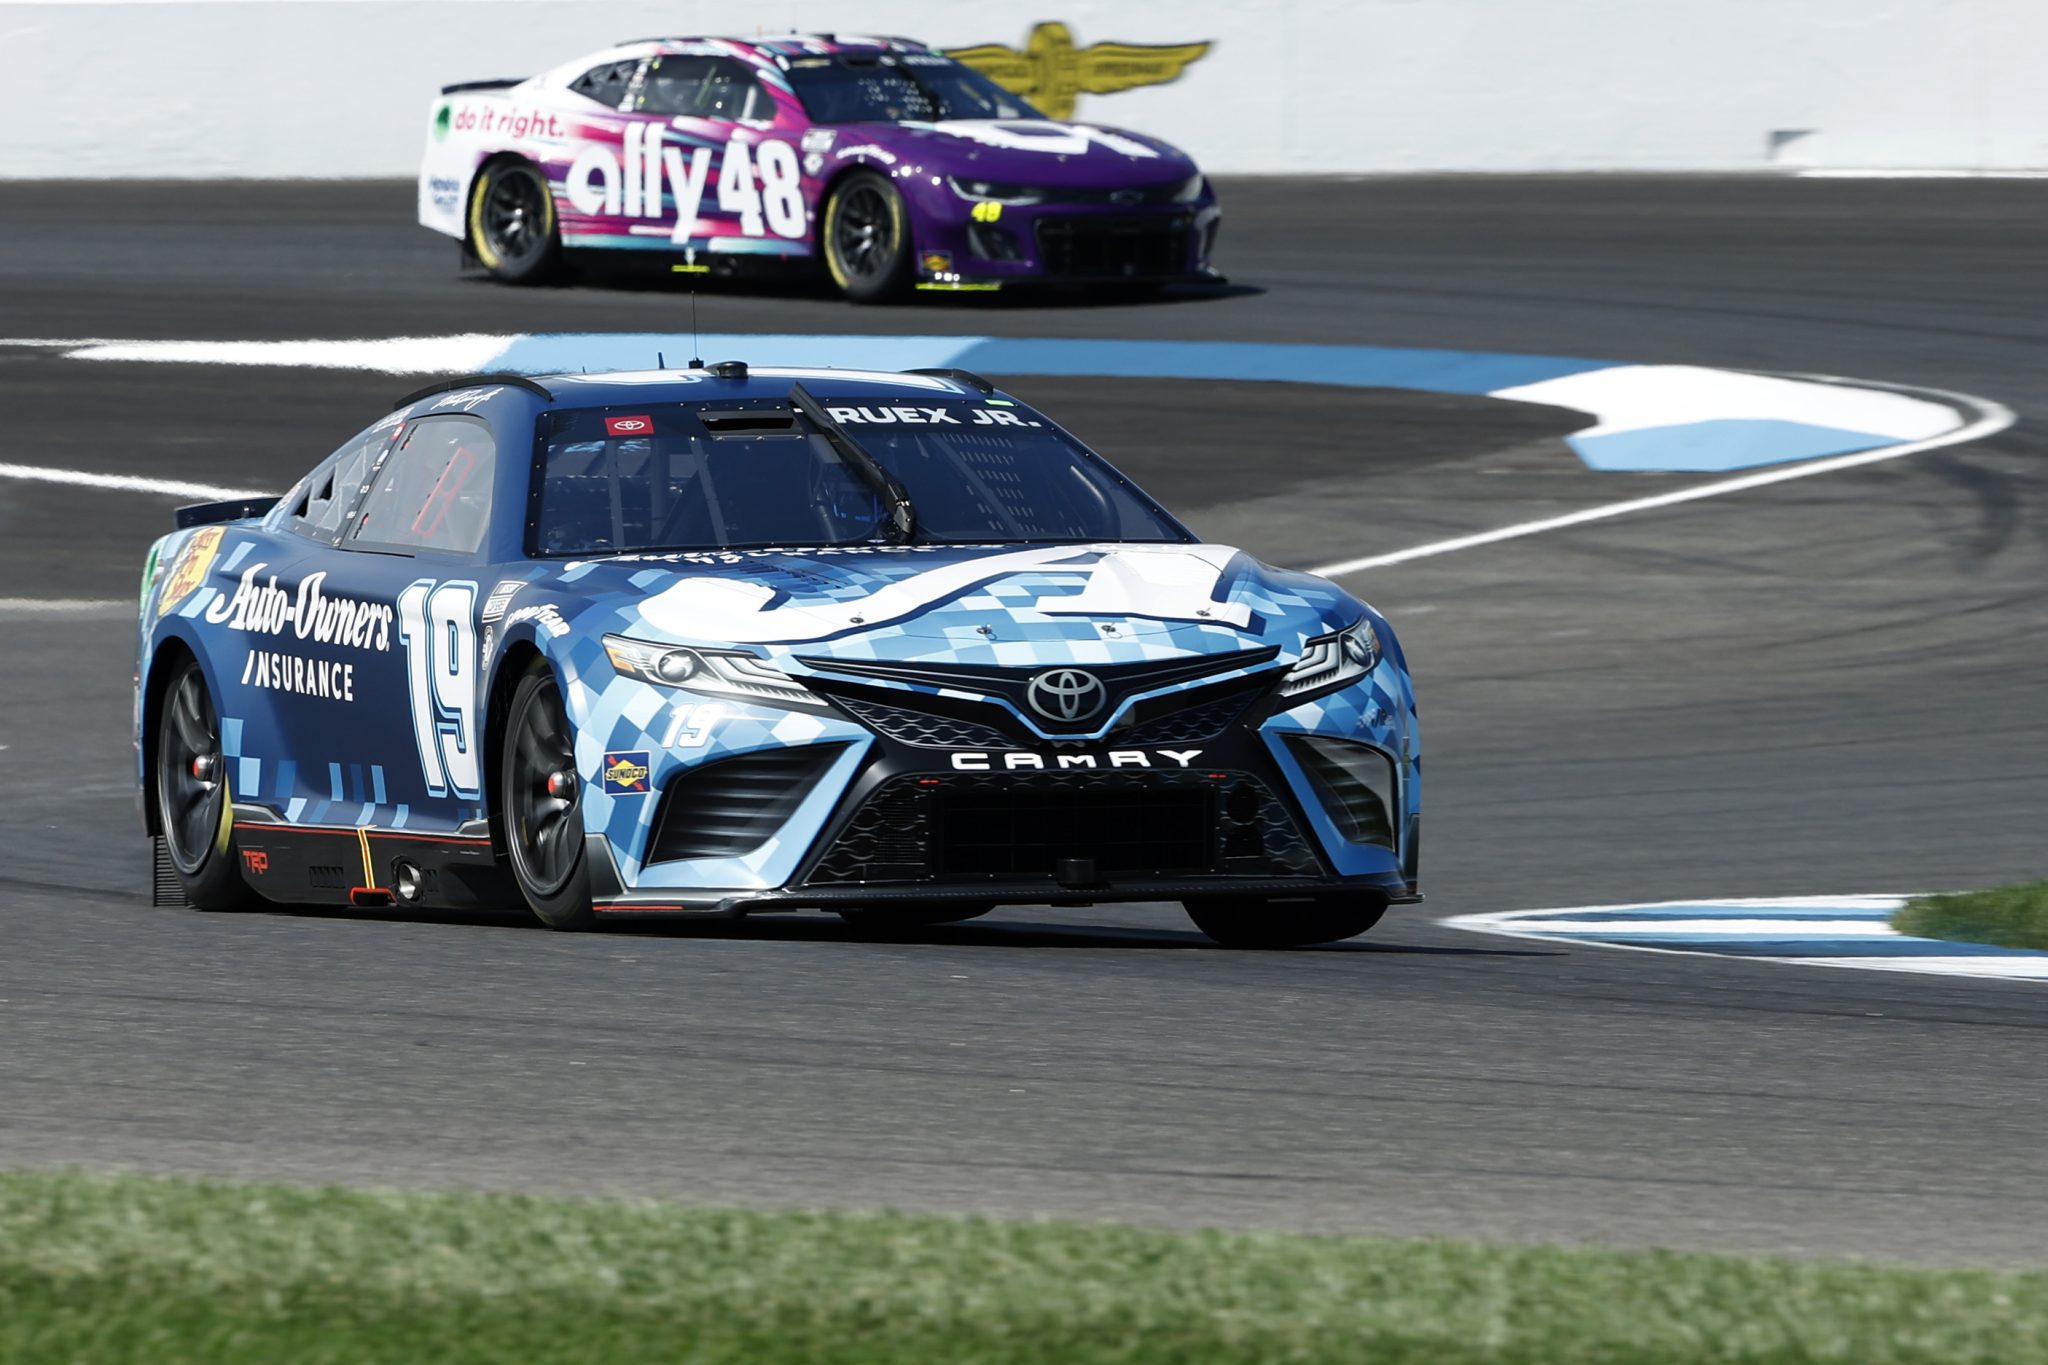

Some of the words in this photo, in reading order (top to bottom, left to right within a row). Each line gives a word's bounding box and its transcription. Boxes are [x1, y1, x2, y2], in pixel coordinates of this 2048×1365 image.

[454, 105, 476, 130] do
[480, 106, 494, 131] it
[498, 107, 564, 139] right.
[565, 121, 713, 245] ally
[717, 138, 807, 239] 48
[971, 201, 1003, 223] 48
[793, 407, 962, 425] RUEX
[972, 408, 1042, 428] JR.
[205, 562, 393, 652] Auto-Owners
[241, 649, 354, 702] INSURANCE
[396, 578, 481, 800] 19
[661, 702, 727, 749] 19
[606, 766, 646, 780] SUNOCO
[950, 750, 1204, 770] CAMRY
